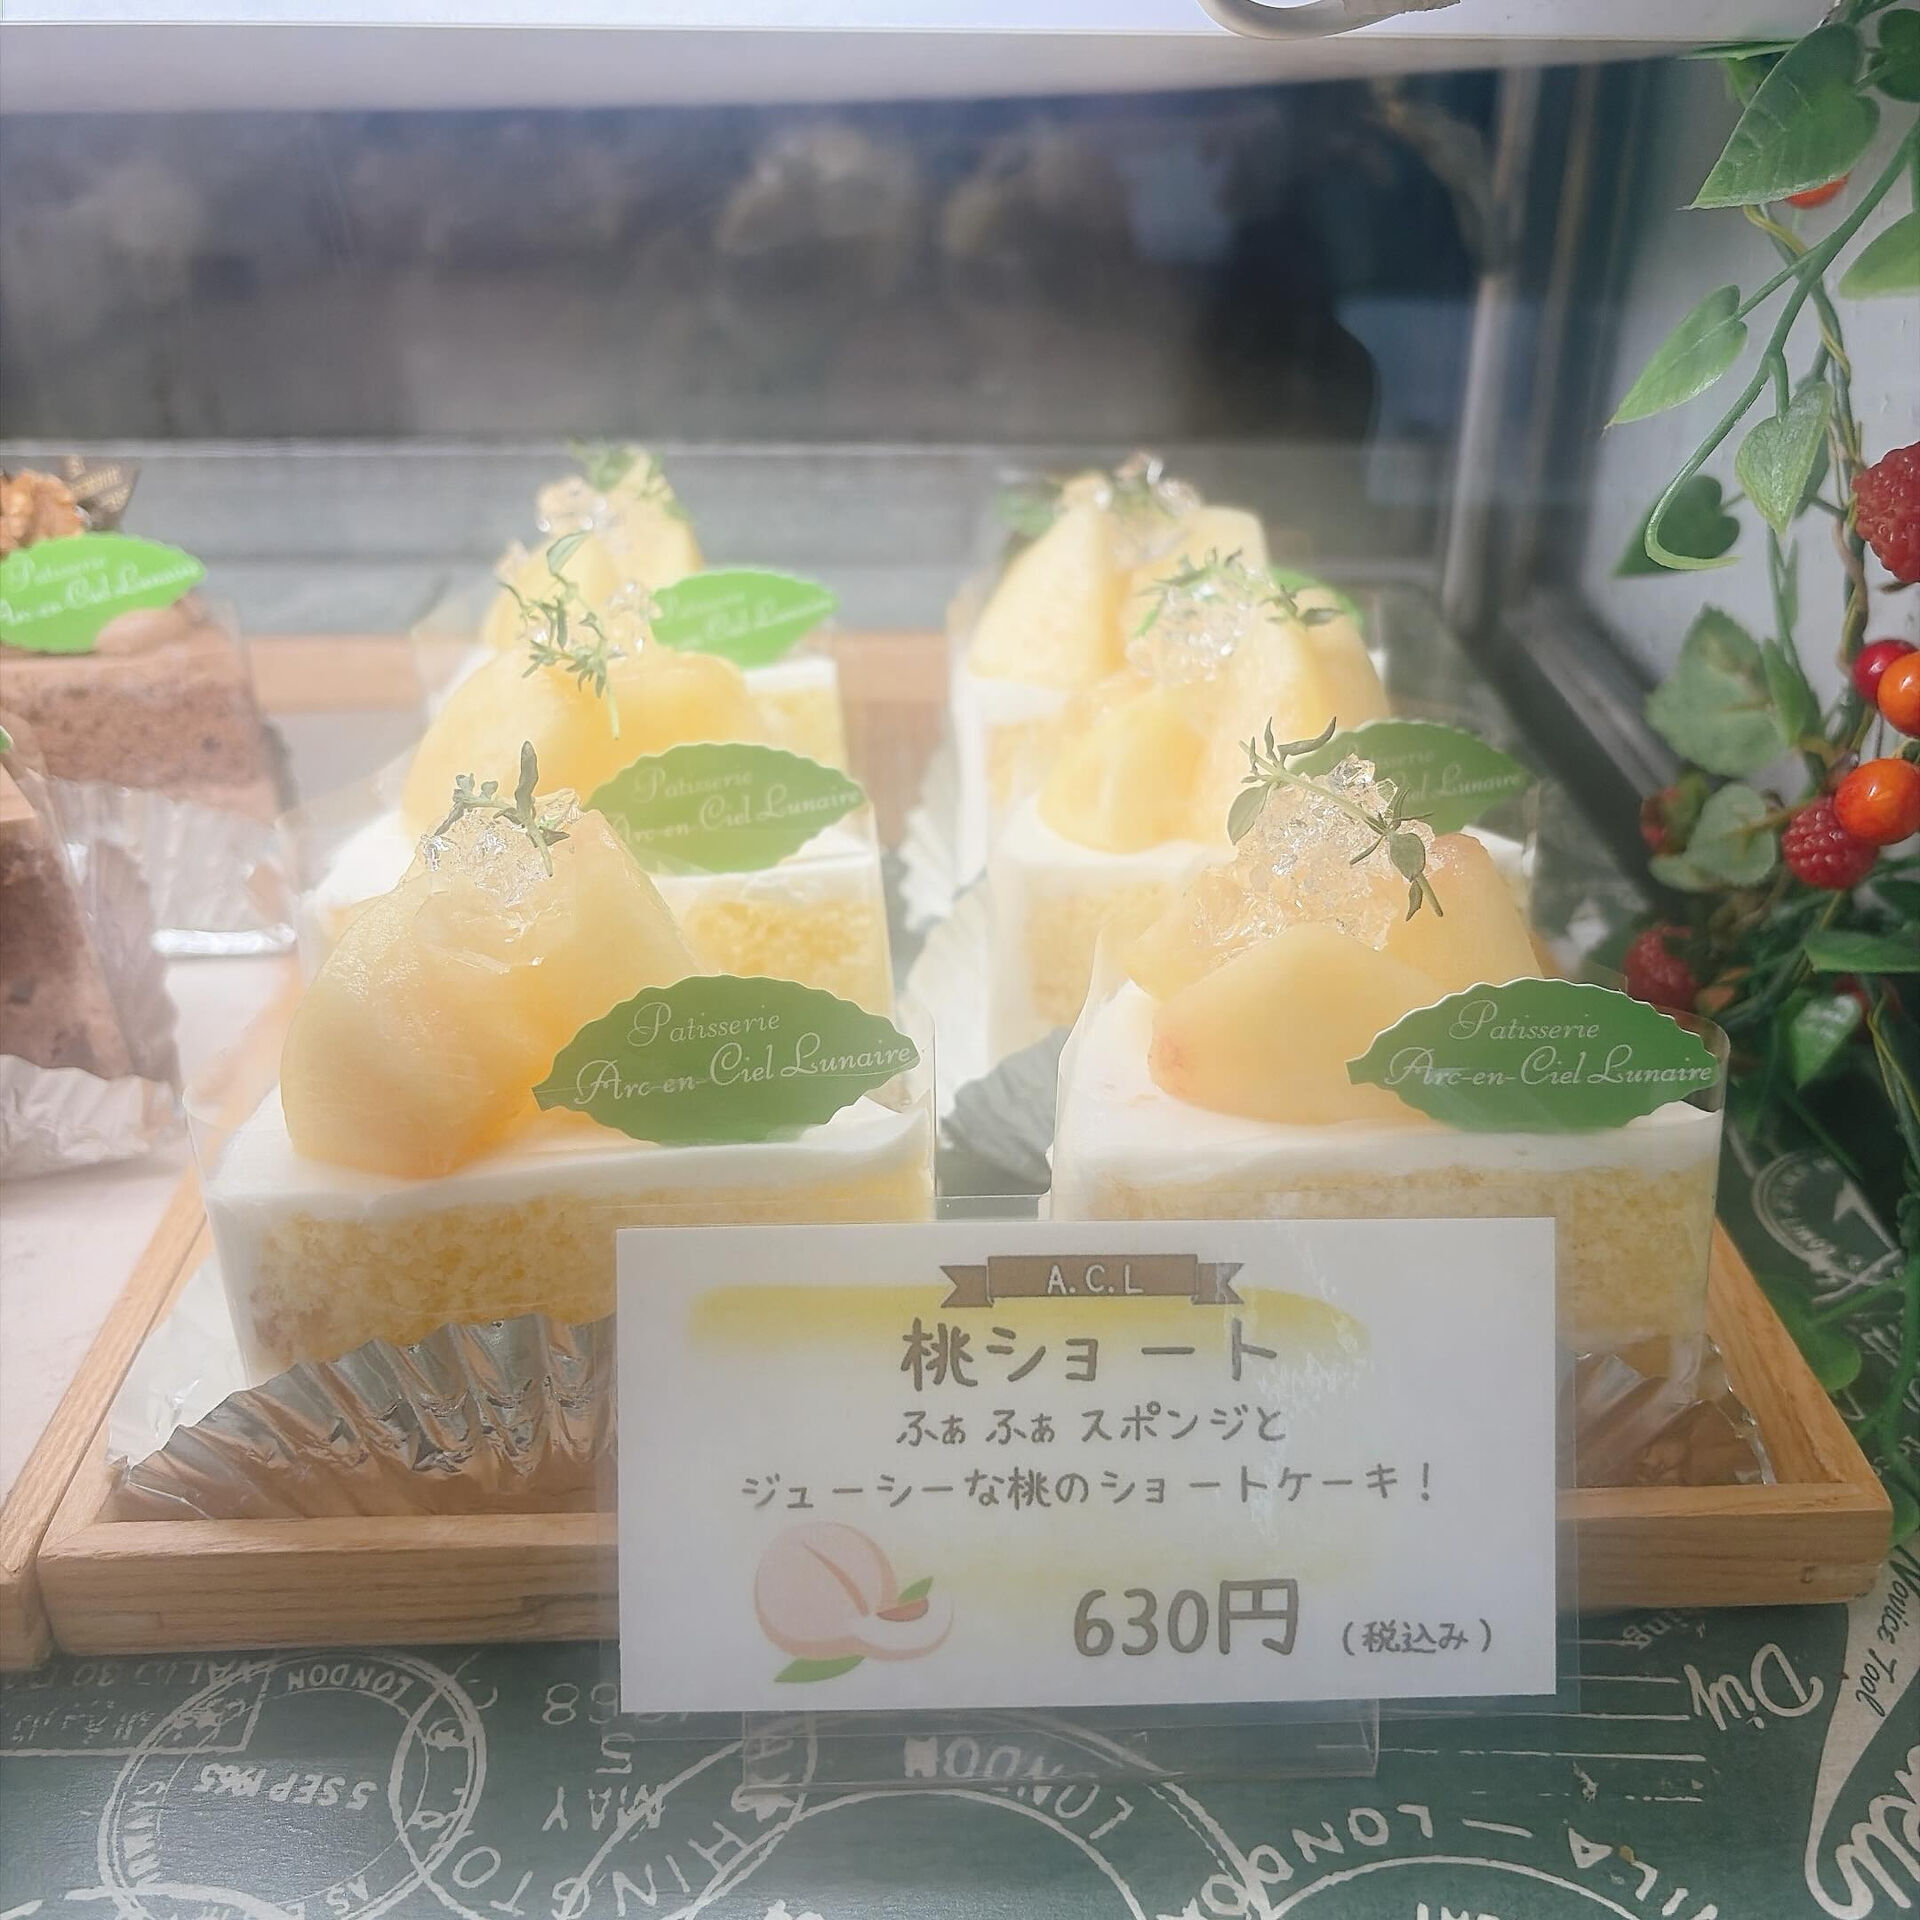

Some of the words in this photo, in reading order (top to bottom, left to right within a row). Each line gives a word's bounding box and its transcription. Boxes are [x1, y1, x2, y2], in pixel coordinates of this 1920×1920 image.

[626, 1001, 782, 1048] Patisserie
[1448, 999, 1602, 1041] Patisserie
[573, 1042, 775, 1105] Arc-en-Ciel
[780, 1032, 912, 1078] Lunaire
[1383, 1045, 1586, 1087] Arc-en-Ciel
[1586, 1043, 1713, 1085] Lunaire
[1046, 1264, 1143, 1296] A.C.L
[901, 1317, 1278, 1391] 桃ショート
[1074, 1578, 1299, 1658] 630円
[286, 1661, 416, 1702] LONDON
[1855, 1651, 1898, 1719] Tool
[595, 1732, 636, 1775] 5
[268, 1771, 348, 1808] SEP
[344, 1780, 378, 1812] 5
[541, 1784, 667, 1832] MAY
